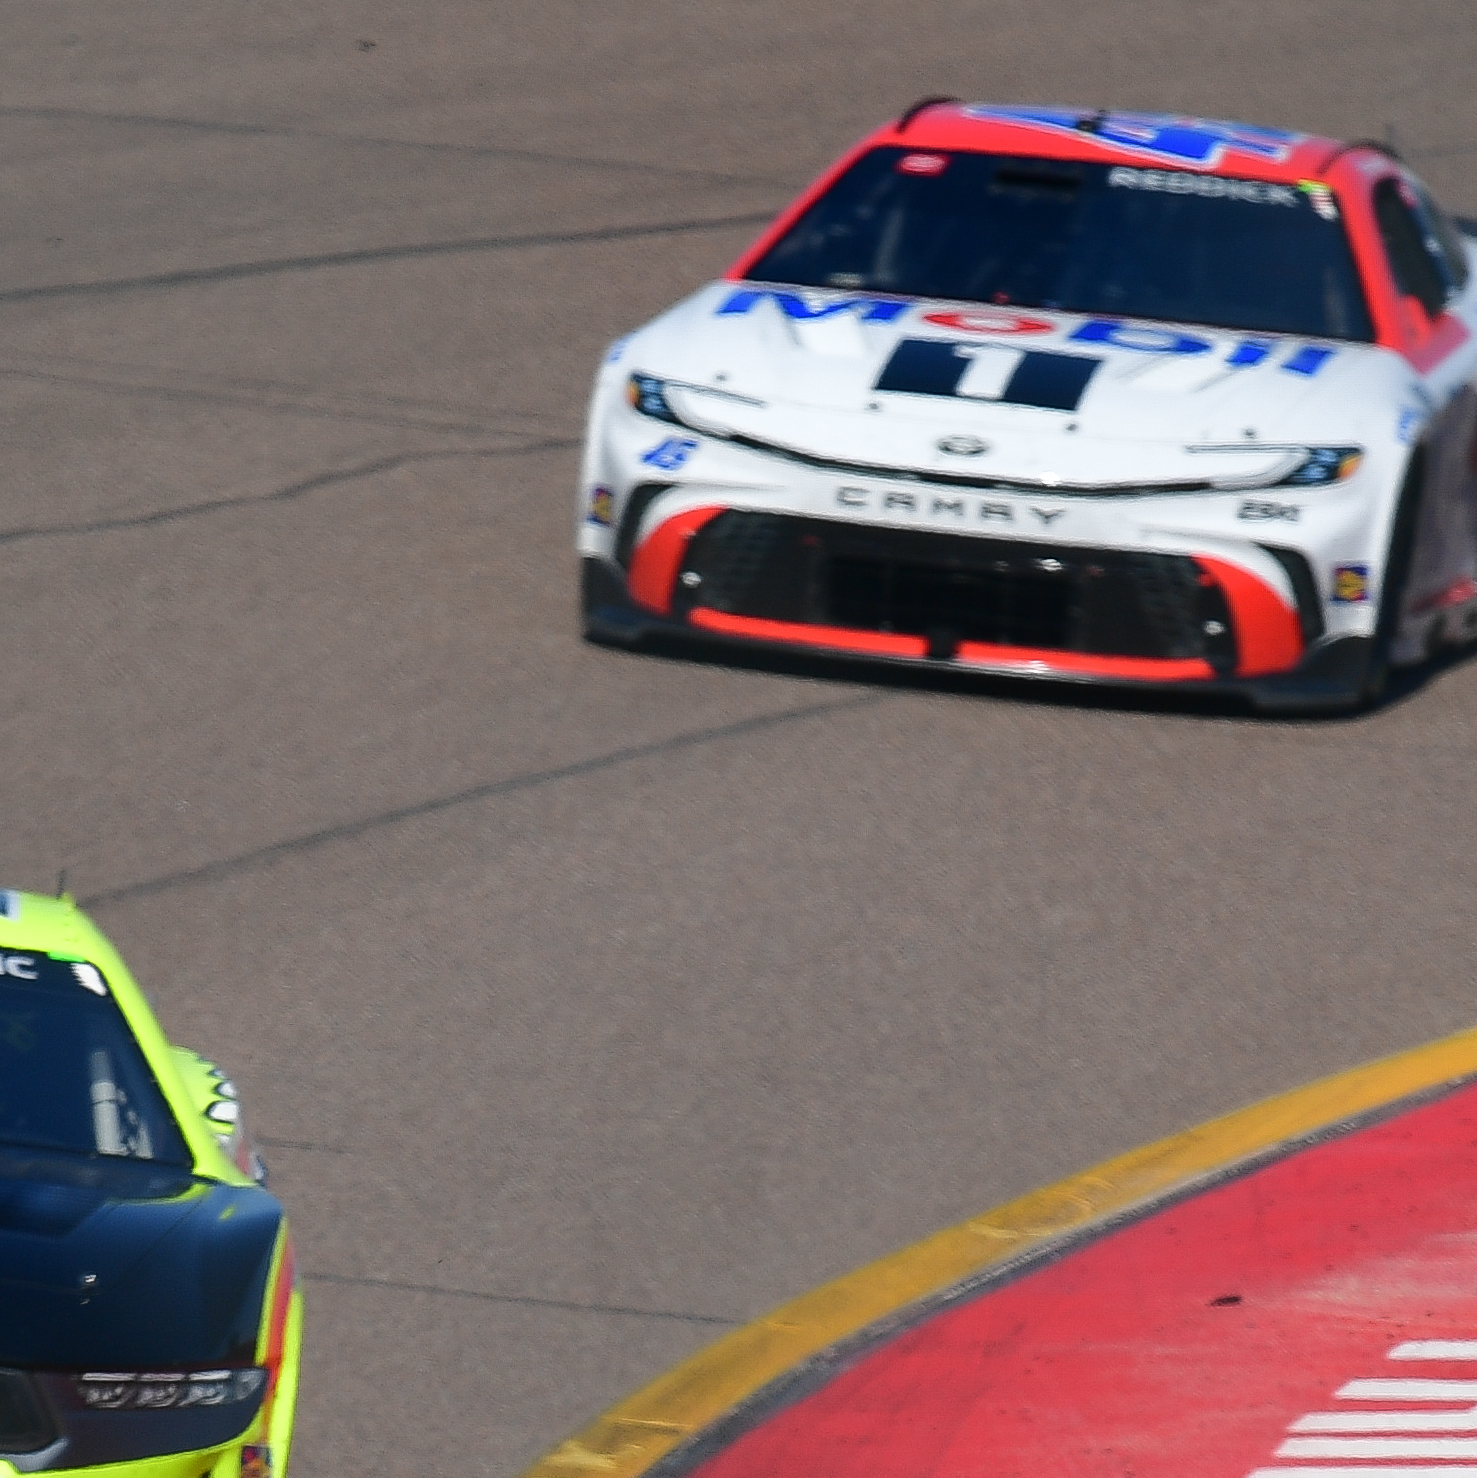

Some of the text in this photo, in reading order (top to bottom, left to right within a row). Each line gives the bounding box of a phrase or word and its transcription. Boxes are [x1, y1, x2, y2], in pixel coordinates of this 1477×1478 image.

[716, 289, 1333, 376] Mobil
[954, 345, 1023, 400] 1
[835, 484, 1065, 526] CAMRY
